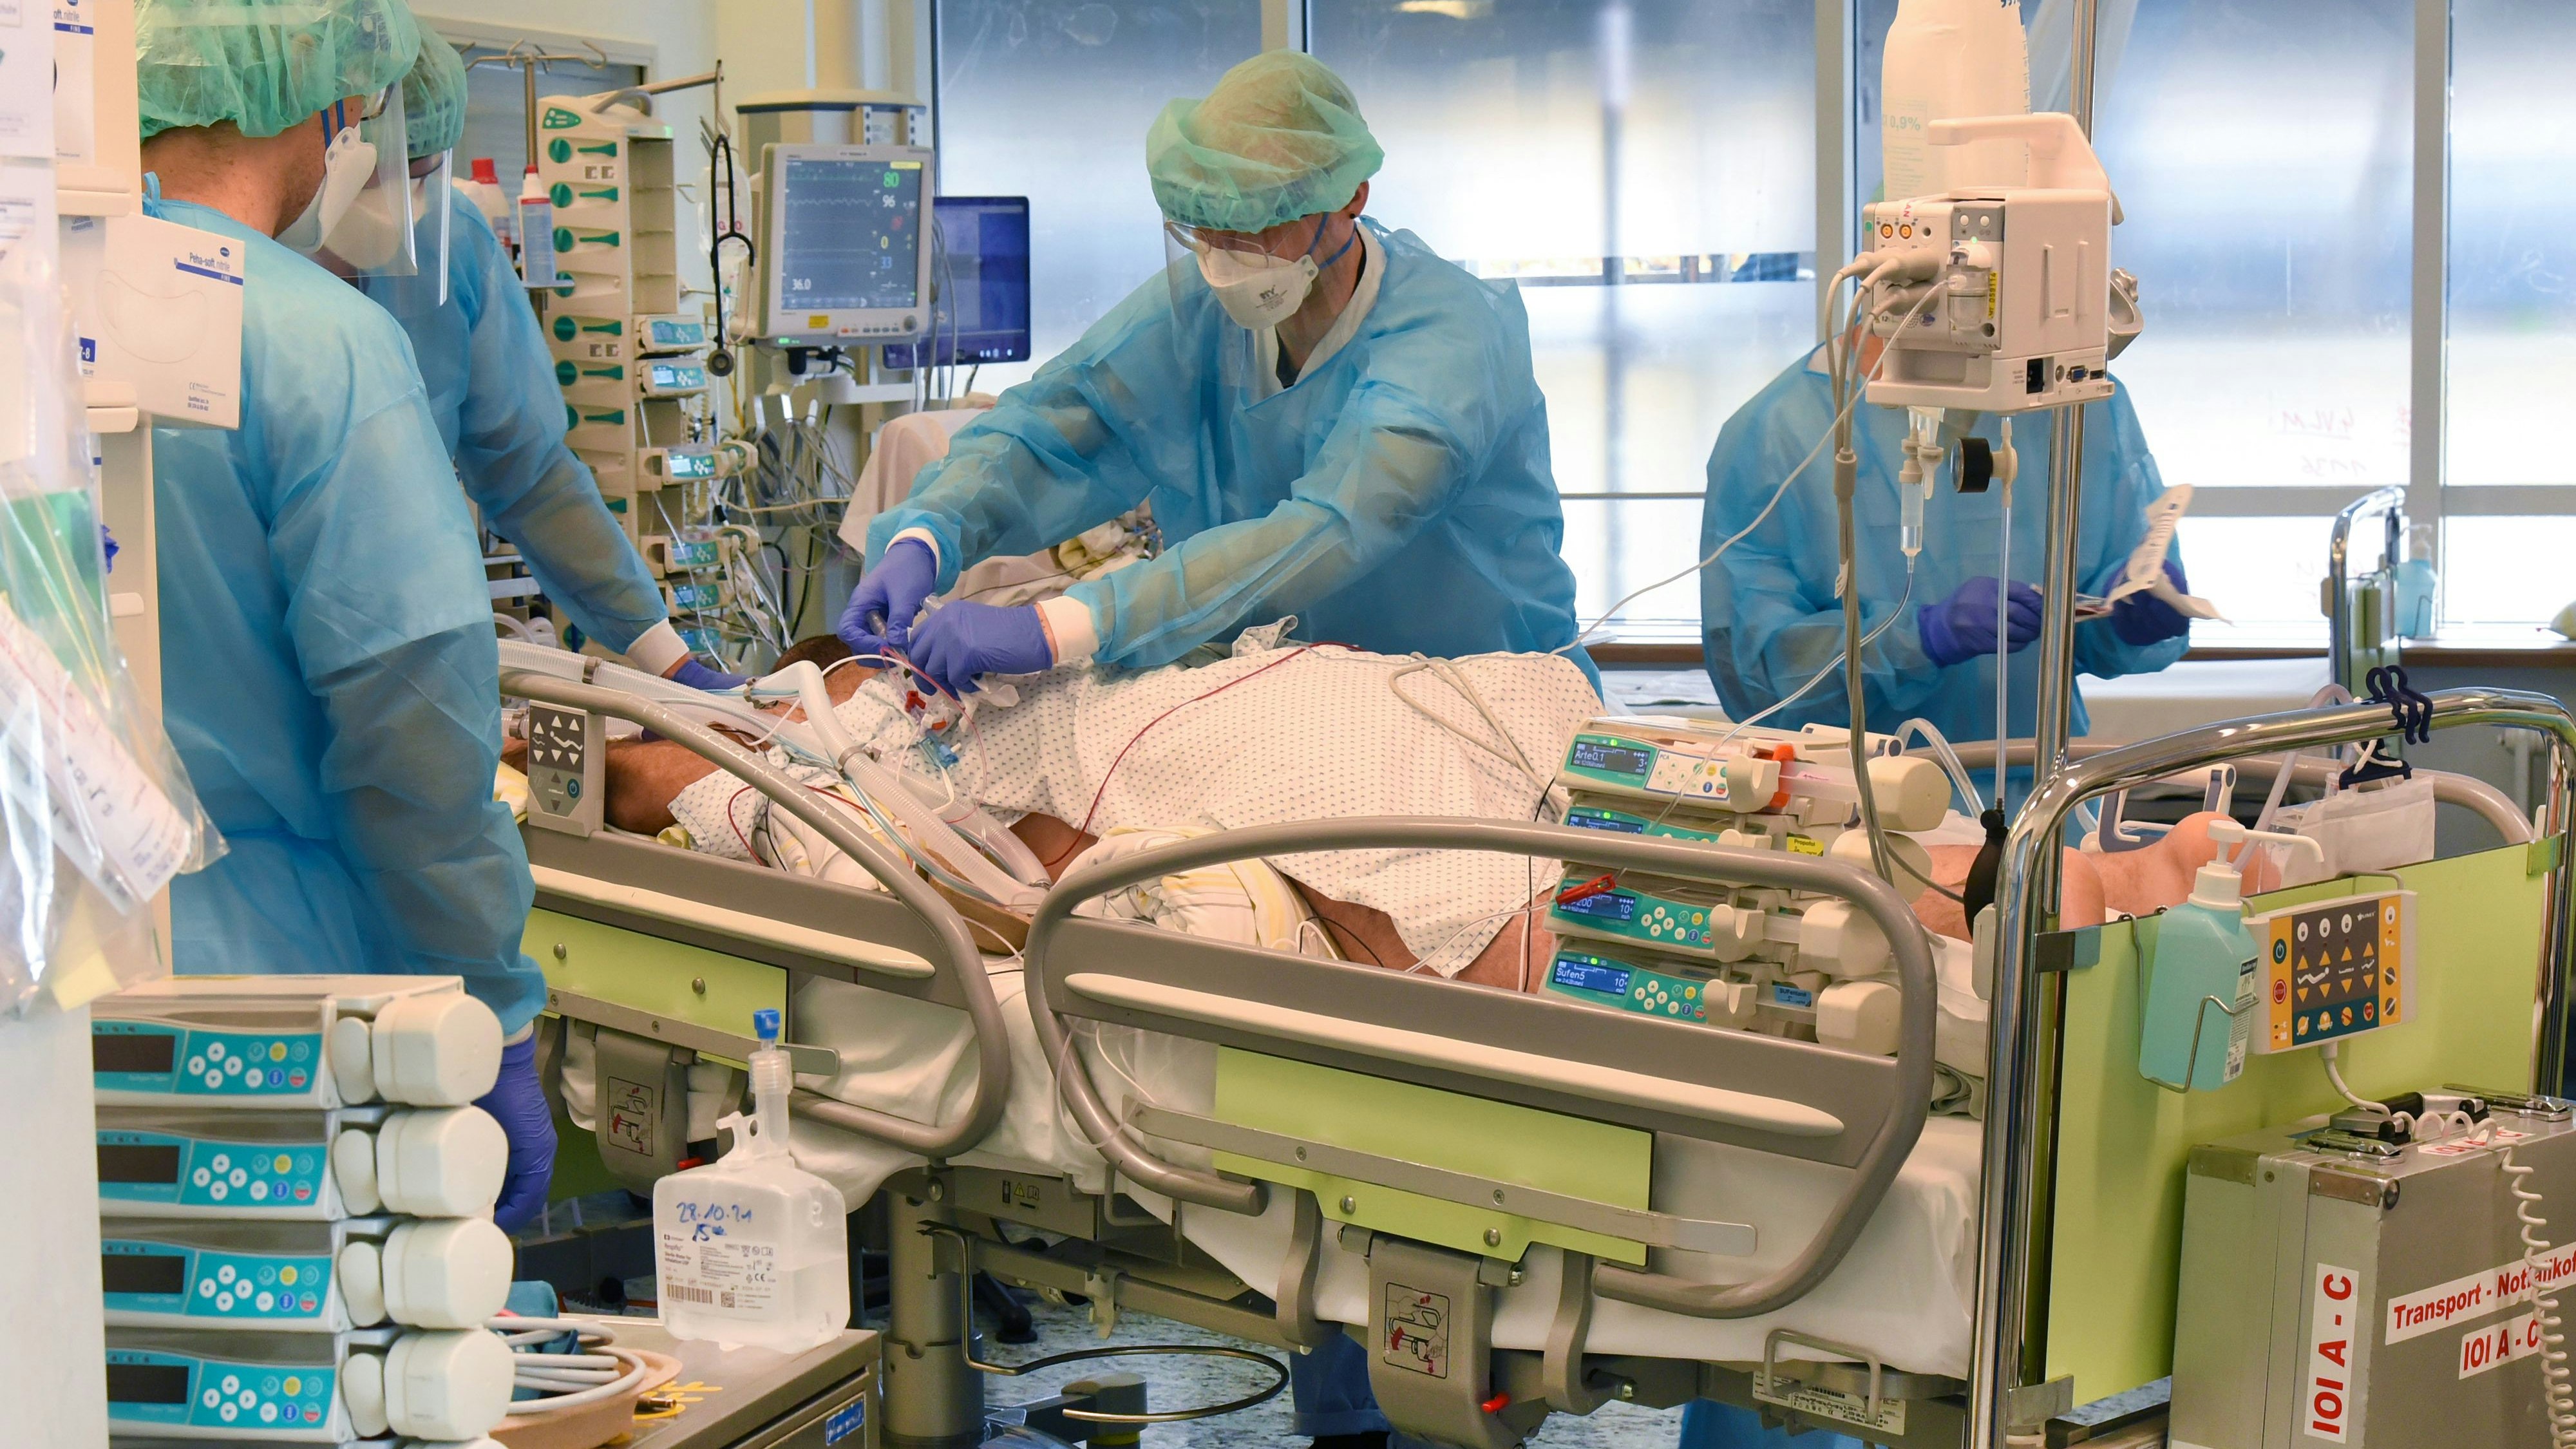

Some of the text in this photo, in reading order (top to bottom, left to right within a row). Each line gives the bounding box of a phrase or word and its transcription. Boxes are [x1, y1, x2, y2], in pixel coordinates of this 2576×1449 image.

[884, 171, 900, 187] 80
[882, 194, 896, 207] 96
[189, 252, 216, 268] Peha-soft
[1575, 750, 1604, 761] Arte0.1
[1638, 759, 1644, 767] 3
[1620, 904, 1630, 914] 10
[1557, 967, 1625, 987] Sufen5 10
[2323, 1273, 2352, 1301] C
[2394, 1282, 2482, 1330] Transport
[2496, 1329, 2510, 1360] A
[2527, 1318, 2538, 1348] C
[2318, 1340, 2347, 1368] A
